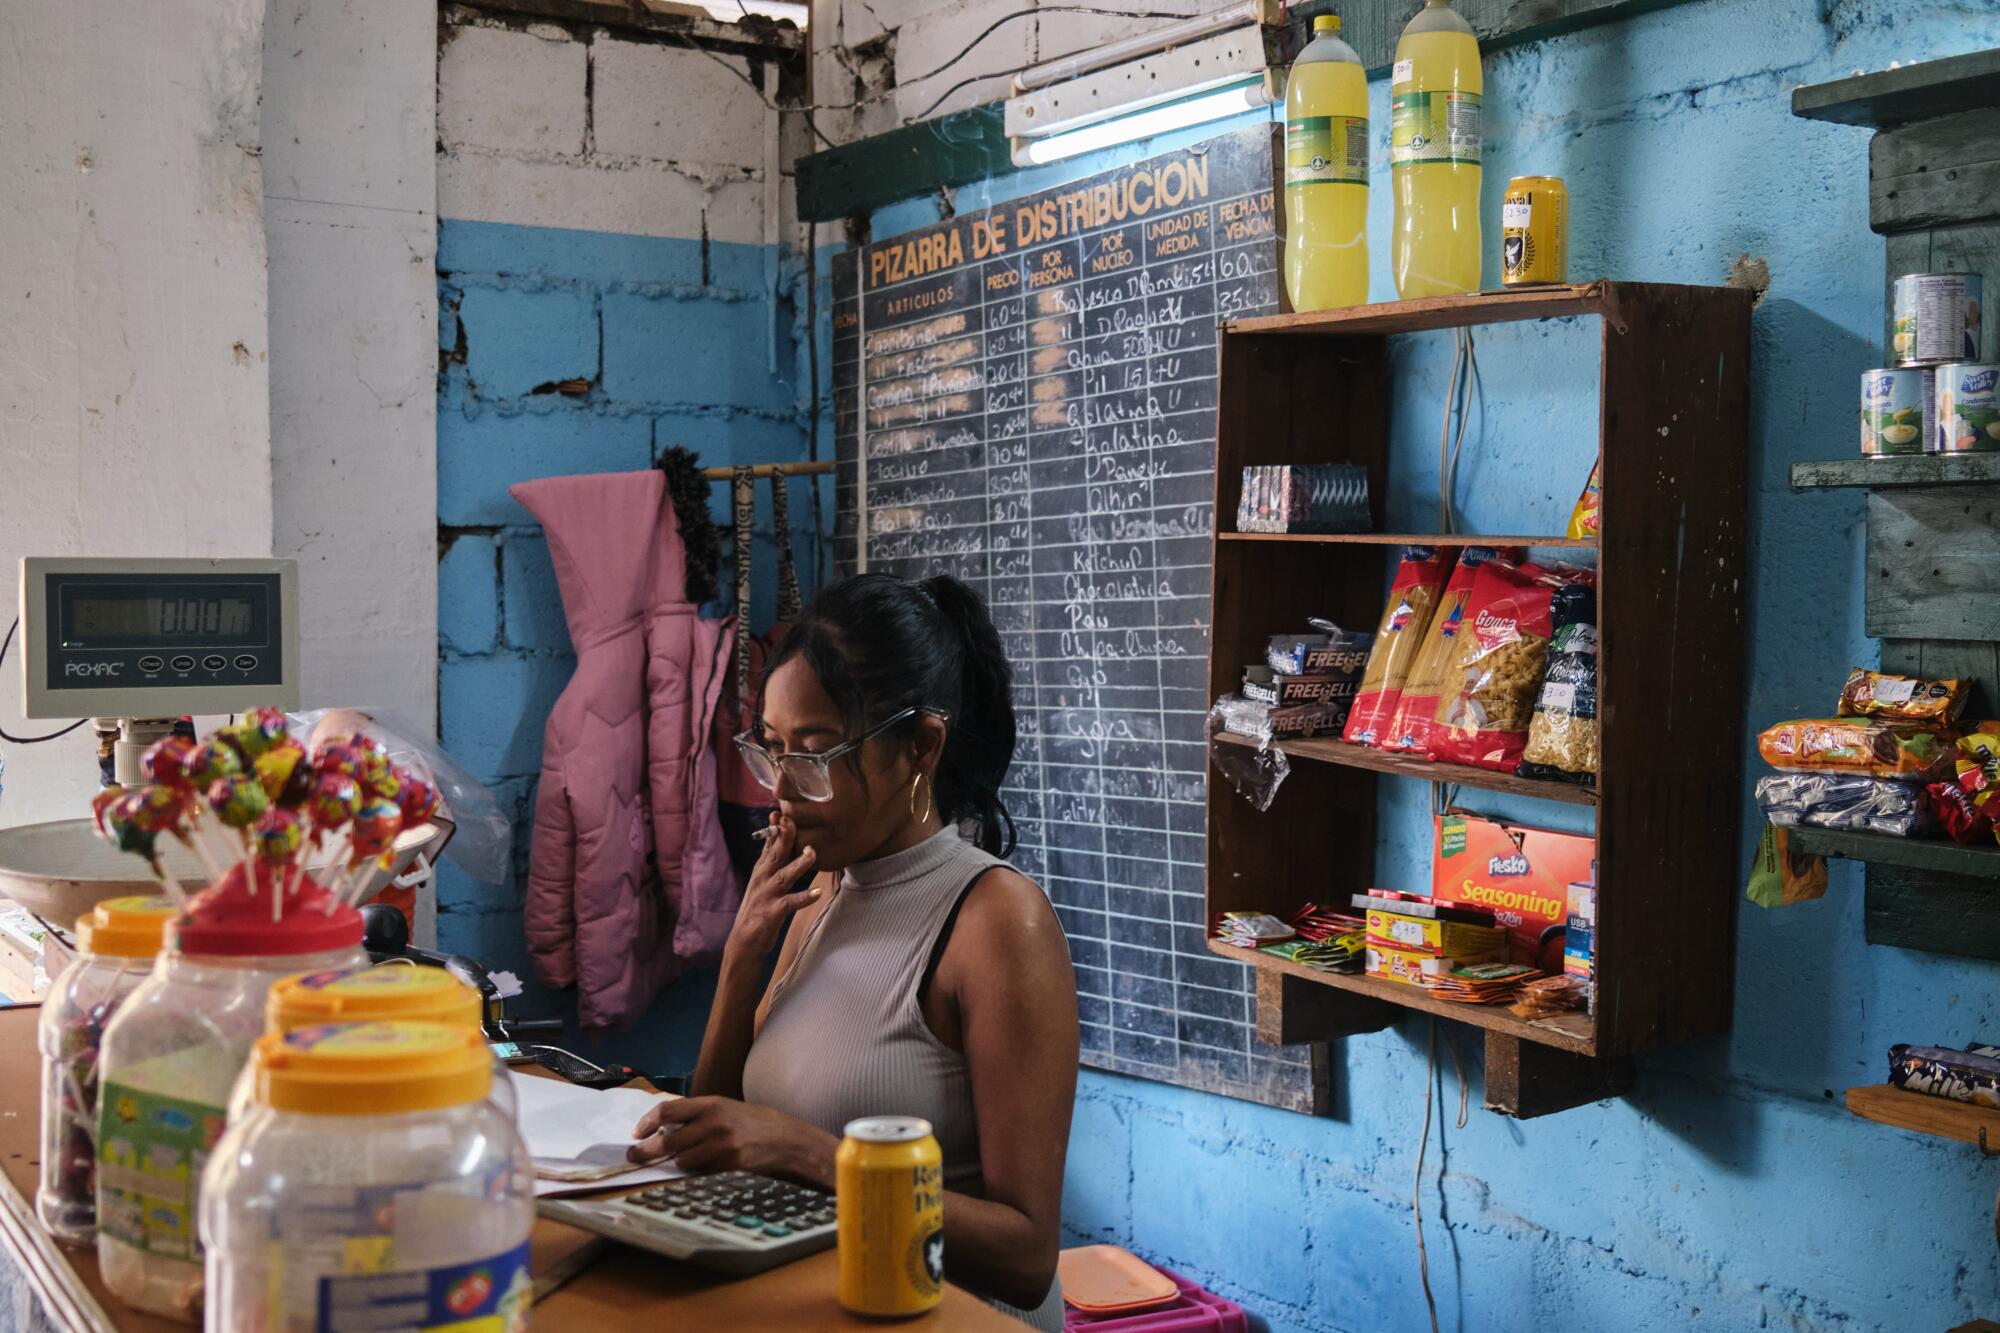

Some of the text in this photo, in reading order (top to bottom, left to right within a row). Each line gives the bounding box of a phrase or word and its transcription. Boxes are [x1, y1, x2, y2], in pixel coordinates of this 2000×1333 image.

[871, 154, 1209, 288] PIZARRA DE DISTRIBUCION
[1219, 196, 1259, 223] FECHA
[1146, 210, 1209, 241] UNIDAD DE
[1102, 233, 1125, 252] POR
[1156, 233, 1200, 257] MEDIDA
[1042, 249, 1063, 267] POR
[1092, 249, 1134, 273] NUCLEO
[987, 269, 1019, 290] PRECIO
[1029, 265, 1074, 288] PERSONA
[887, 285, 954, 316] ARTICULOS
[1459, 879, 1563, 921] Seasoning
[1569, 917, 1587, 929] USB
